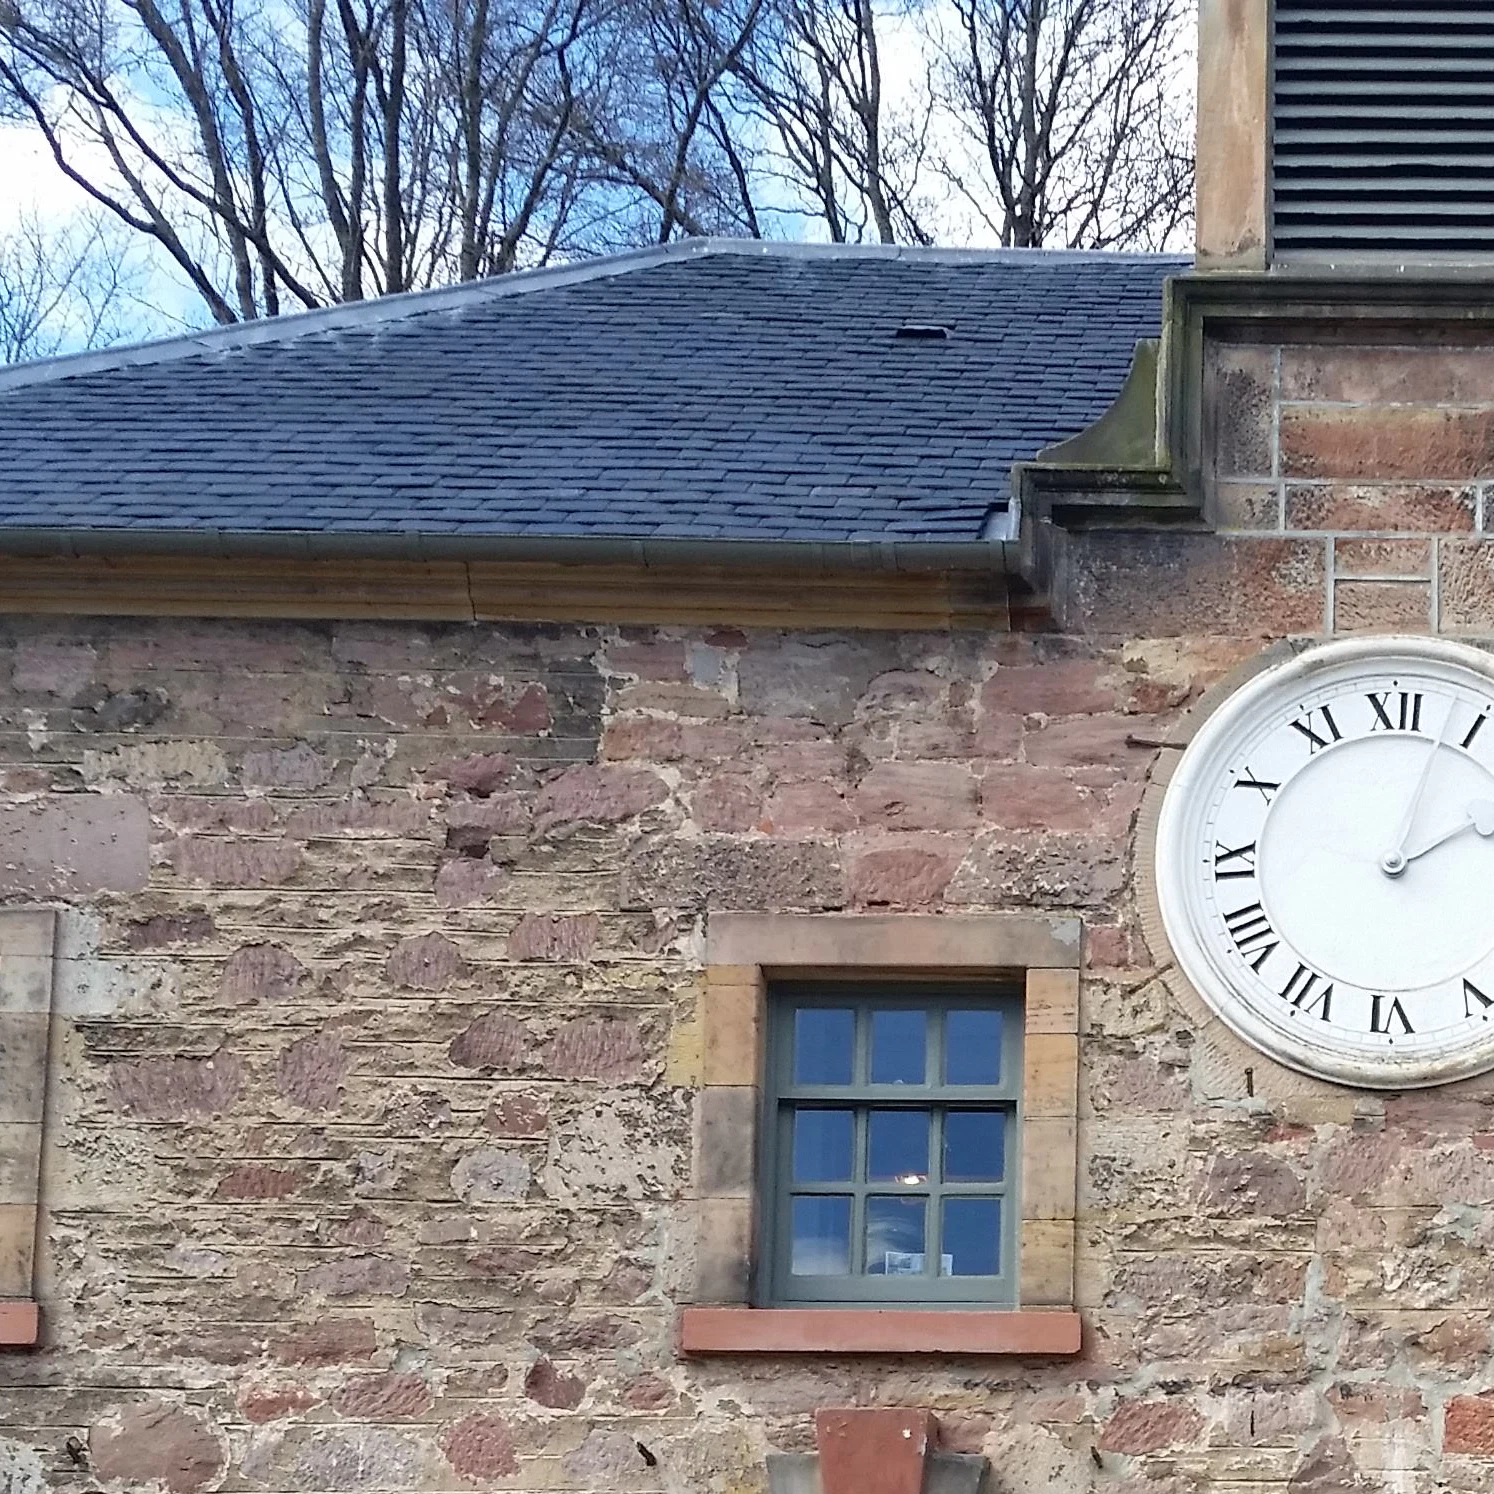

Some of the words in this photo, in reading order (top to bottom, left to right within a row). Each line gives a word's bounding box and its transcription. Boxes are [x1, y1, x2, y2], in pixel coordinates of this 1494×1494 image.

[1289, 704, 1344, 754] XI
[1365, 692, 1424, 732] XII
[1459, 713, 1487, 749] I
[1233, 767, 1281, 805] X
[1215, 839, 1257, 882] IX
[1223, 900, 1280, 974] VIII
[1278, 962, 1334, 1023] VII
[1370, 994, 1415, 1035] VI
